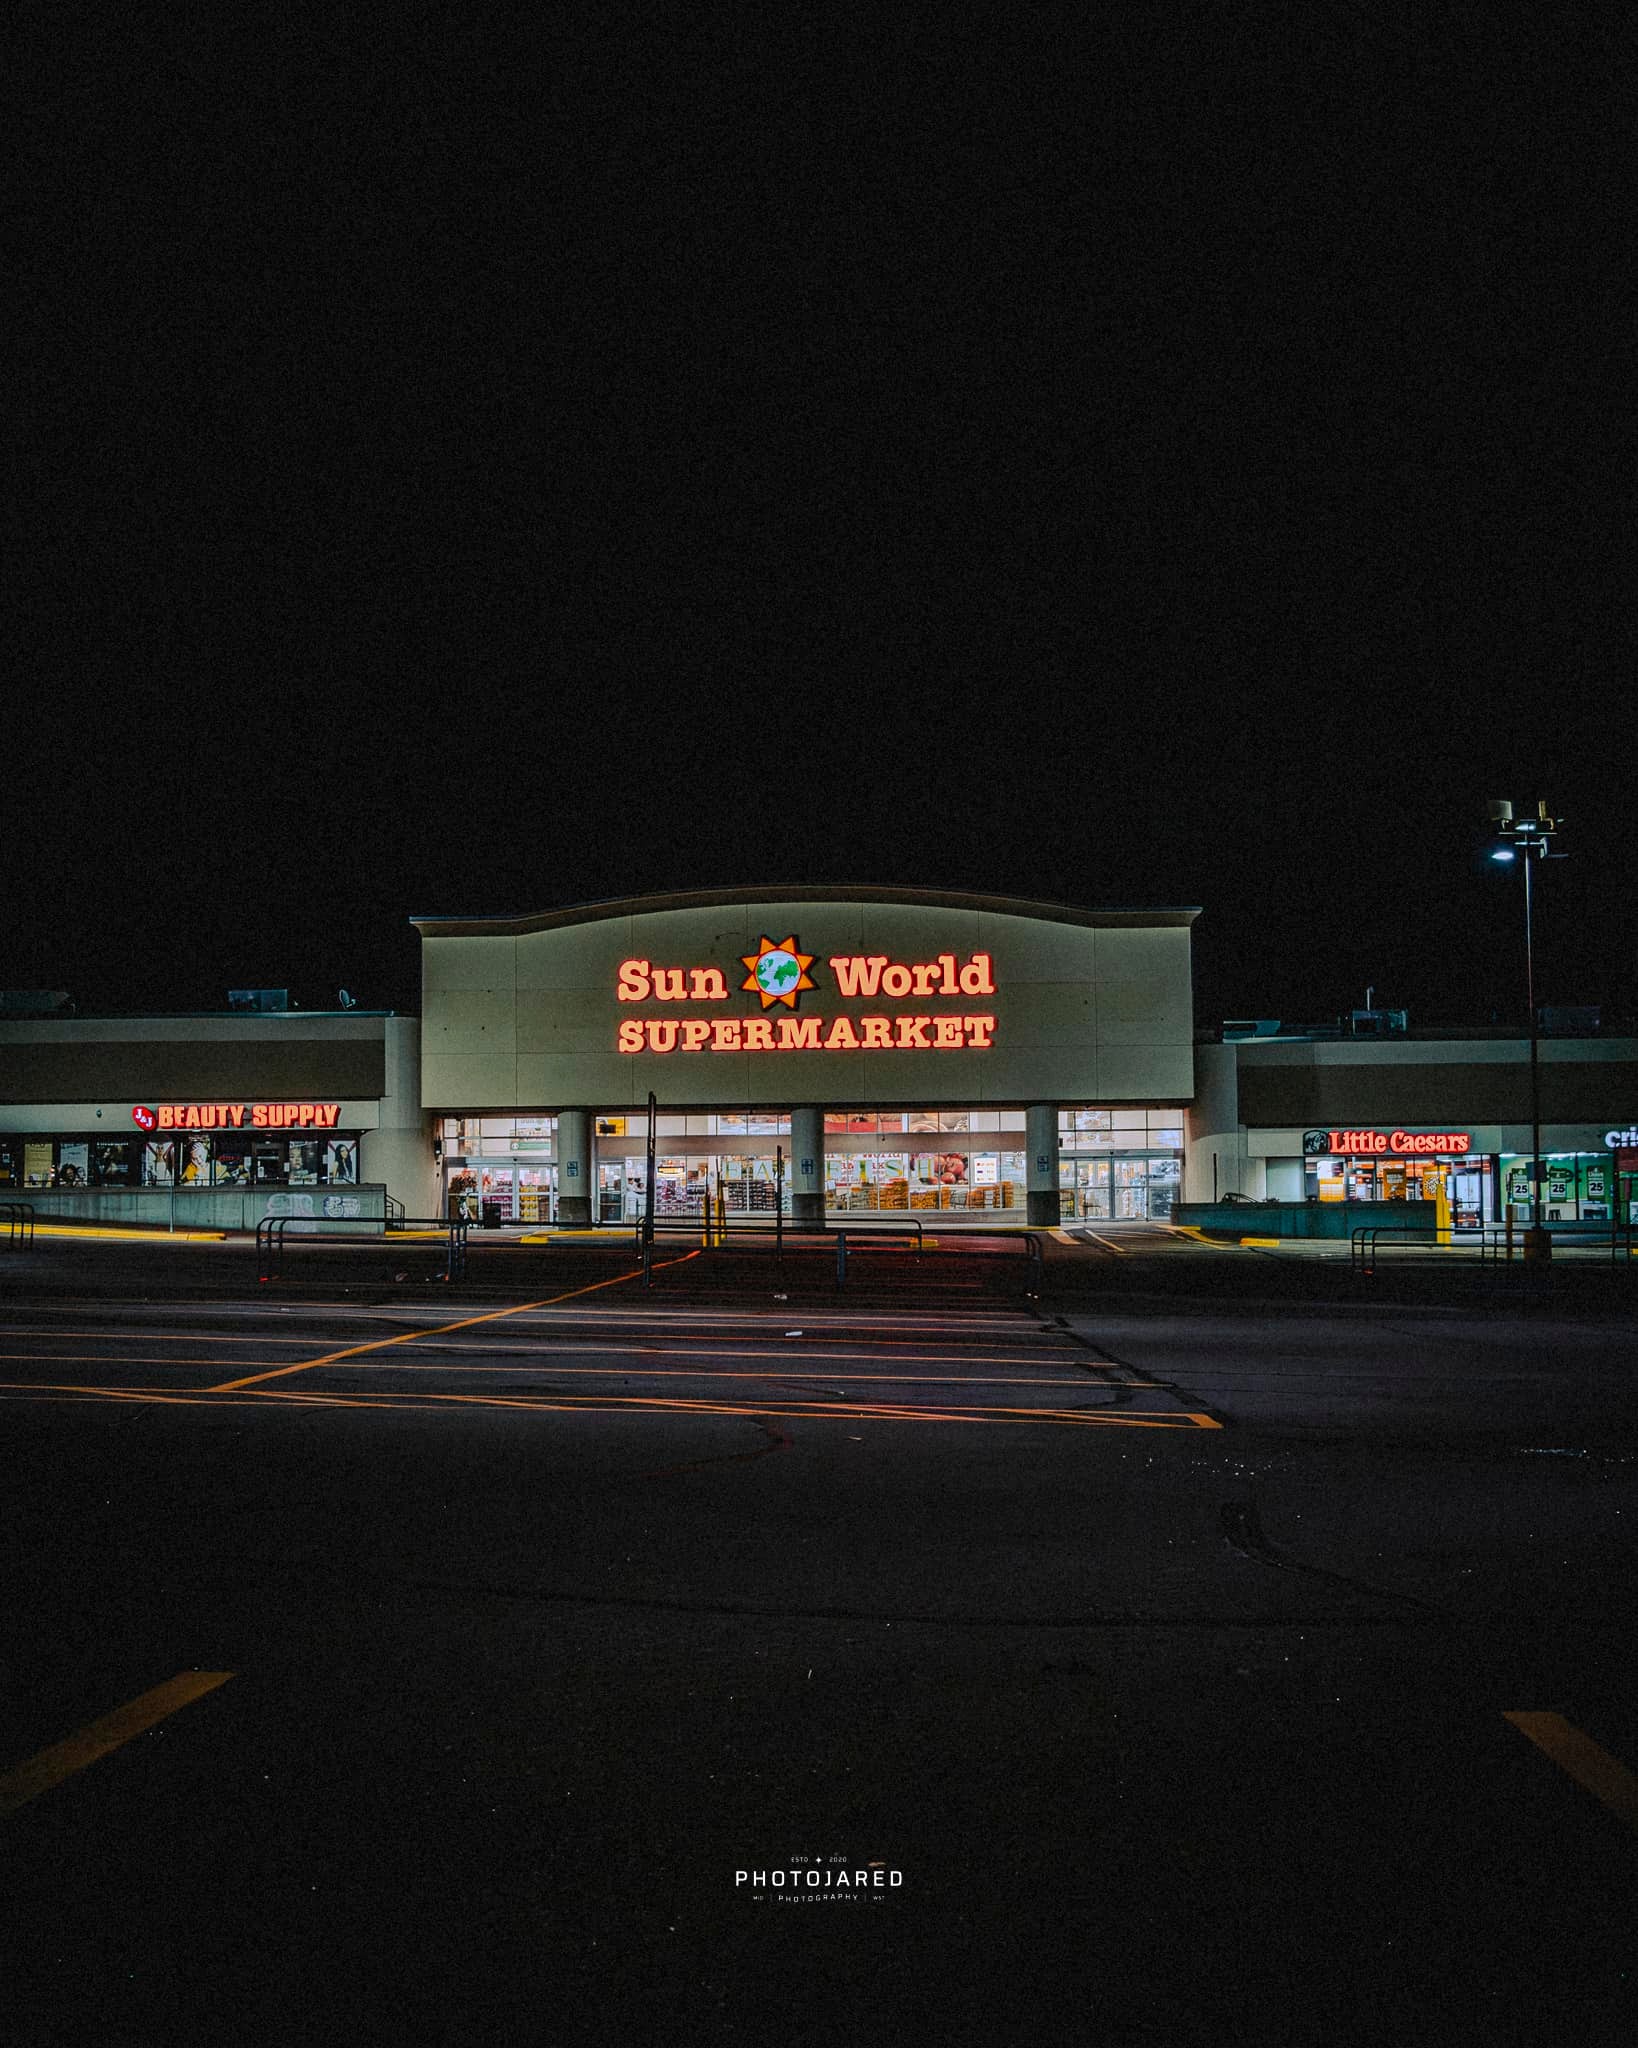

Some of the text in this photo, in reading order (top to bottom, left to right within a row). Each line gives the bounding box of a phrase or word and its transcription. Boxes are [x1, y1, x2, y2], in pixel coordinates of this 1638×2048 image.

[617, 954, 995, 1001] Sun World
[618, 1017, 995, 1053] SUPERMARKET
[158, 1104, 338, 1128] BEAUTY SUPPLY
[1328, 1130, 1470, 1153] Little Caesars
[1605, 1126, 1638, 1148] cri
